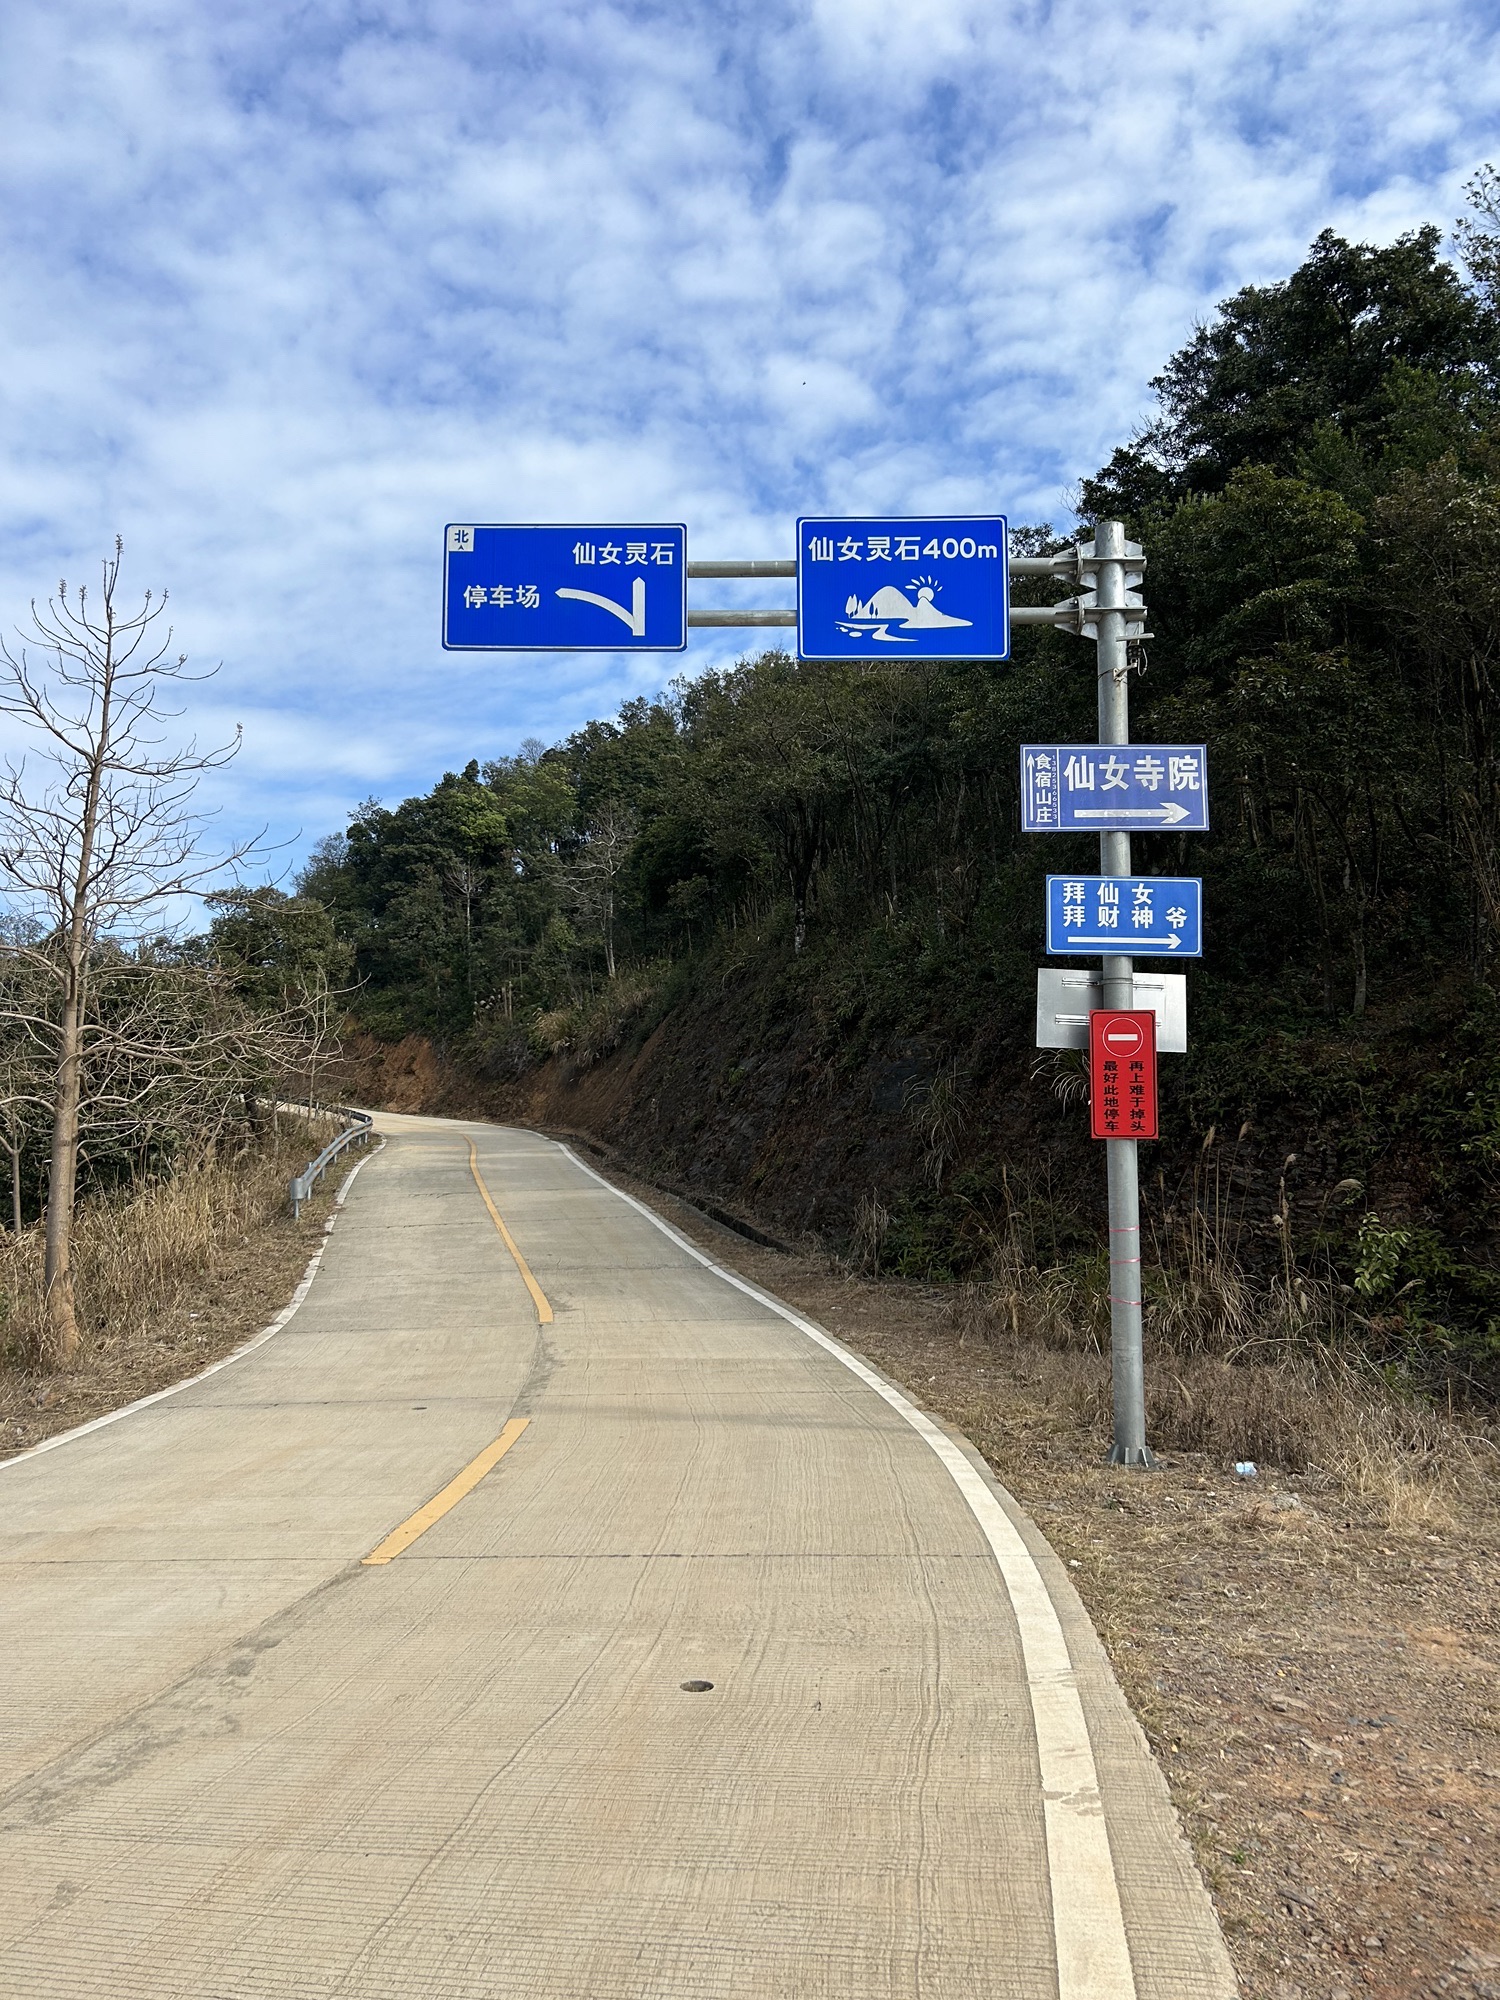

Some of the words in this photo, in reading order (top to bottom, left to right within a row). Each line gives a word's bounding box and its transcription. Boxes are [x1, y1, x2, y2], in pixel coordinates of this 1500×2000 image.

[454, 529, 470, 544] 北
[808, 536, 998, 562] 仙女灵石400m
[572, 542, 675, 566] 仙女灵石
[463, 584, 540, 609] 停车场
[1063, 755, 1200, 791] 仙女寺院
[1035, 753, 1053, 823] 食宿山庄
[1062, 882, 1154, 905] 拜仙女
[1063, 905, 1188, 929] 拜财神爷
[1103, 1060, 1120, 1132] 最好此地停车
[1129, 1060, 1146, 1132] 再上难于掉头
